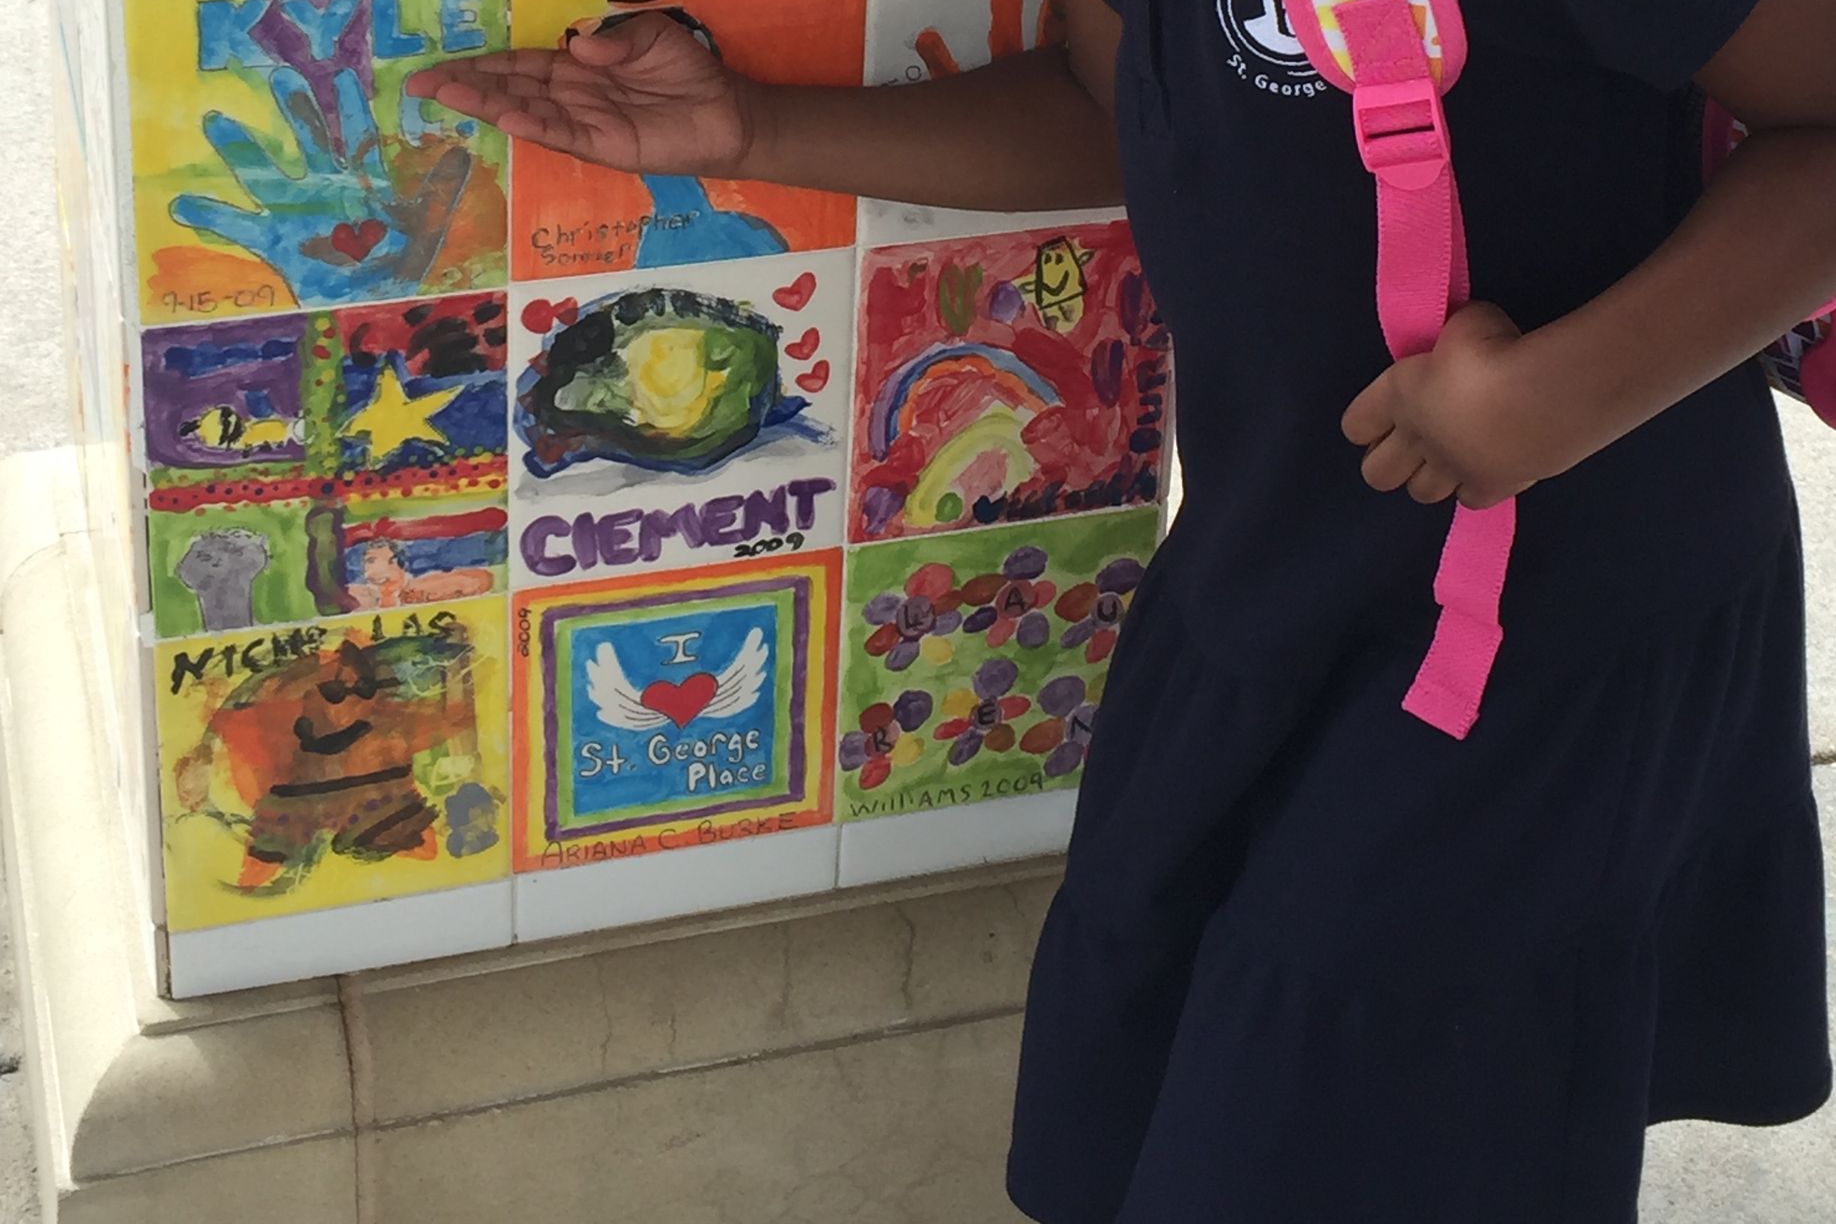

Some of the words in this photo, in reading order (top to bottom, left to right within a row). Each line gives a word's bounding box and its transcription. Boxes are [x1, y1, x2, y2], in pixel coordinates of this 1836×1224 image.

[1254, 74, 1328, 98] George
[734, 532, 805, 558] 2009
[657, 631, 702, 665] I
[580, 742, 637, 777] St.
[648, 728, 760, 764] George
[687, 762, 767, 792] Place
[982, 772, 1045, 797] 2009
[541, 835, 647, 867] ARIANA
